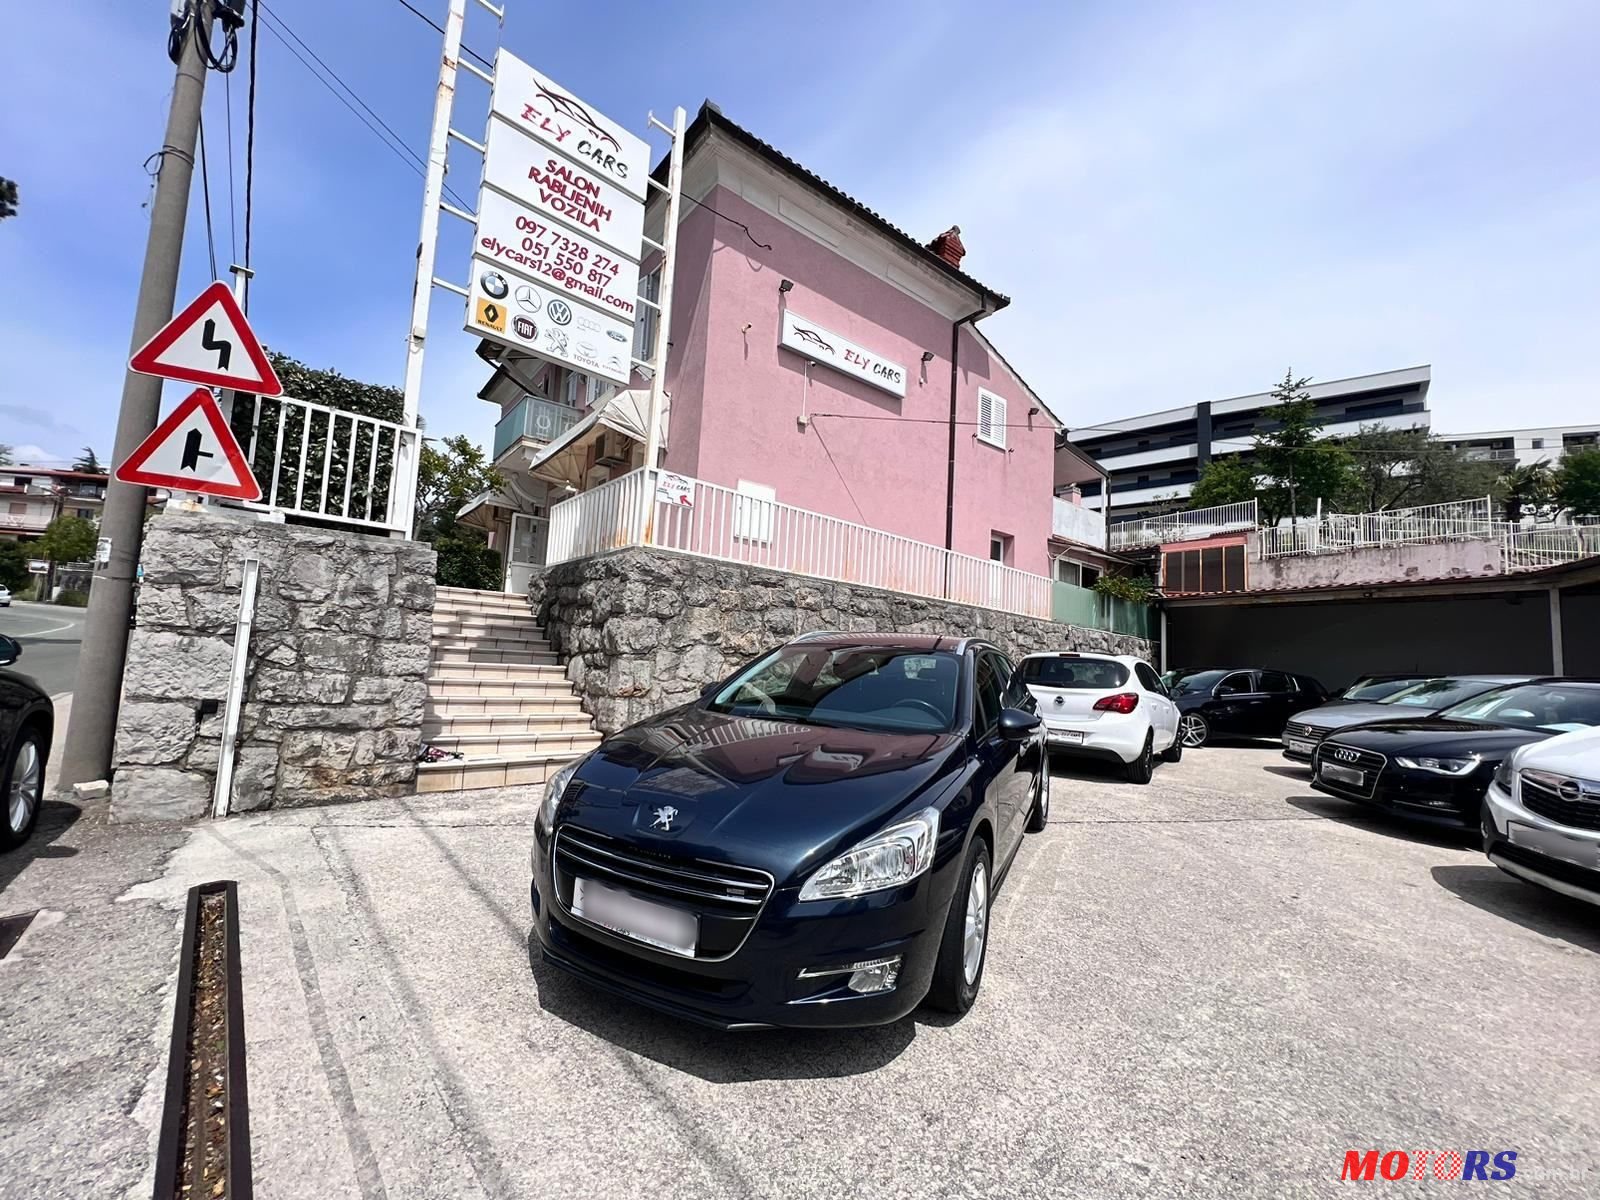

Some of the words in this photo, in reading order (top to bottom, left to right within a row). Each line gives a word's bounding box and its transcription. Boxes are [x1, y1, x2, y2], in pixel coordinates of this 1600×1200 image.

[521, 103, 572, 142] ELY
[577, 140, 628, 179] CARS
[528, 166, 612, 222] RABLJENIH
[545, 159, 600, 198] SALON
[539, 188, 600, 232] VOZILA
[515, 216, 547, 238] 097
[551, 232, 589, 260] 7328
[592, 254, 620, 276] 274
[521, 237, 550, 259] 051
[554, 253, 583, 275] 550
[587, 269, 612, 288] 817
[481, 236, 634, 314] elycars12@gmail.com
[517, 320, 534, 337] FIAT
[573, 354, 599, 368] TOYOTA
[844, 349, 870, 370] ELY
[873, 363, 901, 384] CARS
